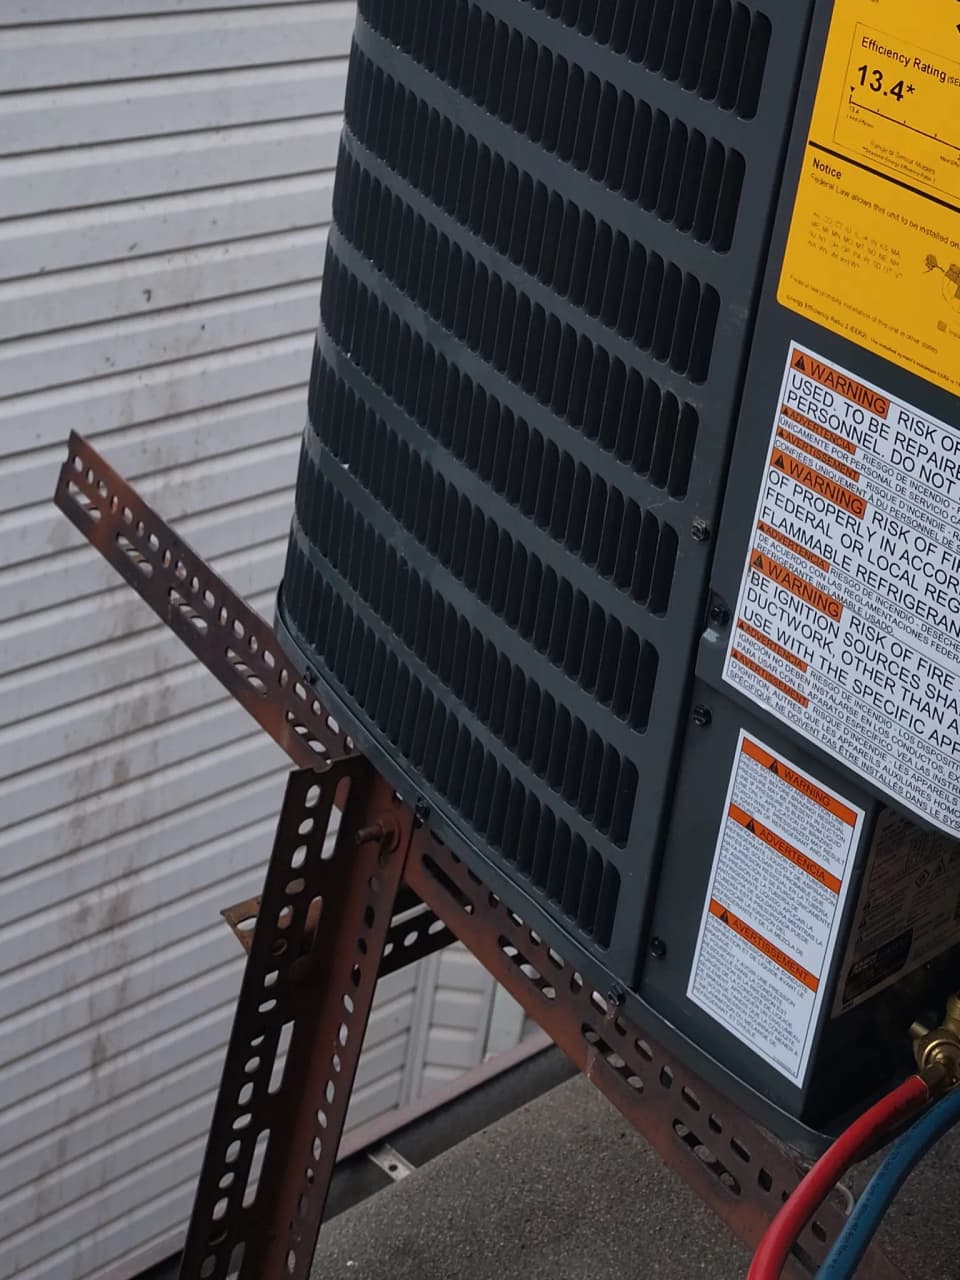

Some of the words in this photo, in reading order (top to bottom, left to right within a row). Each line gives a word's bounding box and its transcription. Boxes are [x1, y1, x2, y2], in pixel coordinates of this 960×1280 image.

[862, 36, 911, 68] Efficiency
[913, 58, 947, 83] Rating
[812, 157, 842, 180] Notice
[792, 374, 837, 412] USED.
[843, 401, 864, 425] TO
[868, 418, 890, 440] BE
[810, 360, 887, 414] WARNING
[898, 411, 937, 444] RISK
[787, 391, 885, 458] PERSONNEL.
[890, 449, 915, 472] DO
[919, 466, 956, 494] NOT
[850, 458, 893, 489] PERSONAL
[762, 506, 852, 572] FLAMMABLE
[766, 487, 833, 539] FEDERAL
[840, 533, 864, 557] OR
[867, 549, 919, 591] LOCAL
[769, 470, 789, 490] OF
[793, 486, 876, 542] PROPERLY
[880, 536, 896, 556] IN
[790, 460, 863, 516] WARNING
[873, 511, 910, 544] RISK
[914, 536, 938, 557] OF
[756, 544, 815, 584] REFRIGERANTE
[816, 581, 863, 614] INFLAMABLE
[747, 588, 836, 659] DUCTWORK,
[841, 650, 896, 694] OTHER
[902, 686, 945, 724] THAN
[751, 570, 770, 594] BE
[774, 588, 840, 638] IGNITION
[843, 632, 920, 690] SOURCES
[768, 560, 840, 618] WARNING
[850, 615, 887, 649] RISK
[891, 642, 914, 663] OF
[917, 658, 955, 692] FIRE
[744, 605, 772, 636] USE
[777, 628, 815, 665] WITH
[820, 655, 849, 686] THE
[852, 680, 925, 735] SPECIFIC
[783, 768, 831, 807] WARNING
[759, 829, 826, 881] ADVERTENCIA
[733, 920, 809, 981] AVERTISSEMENT
